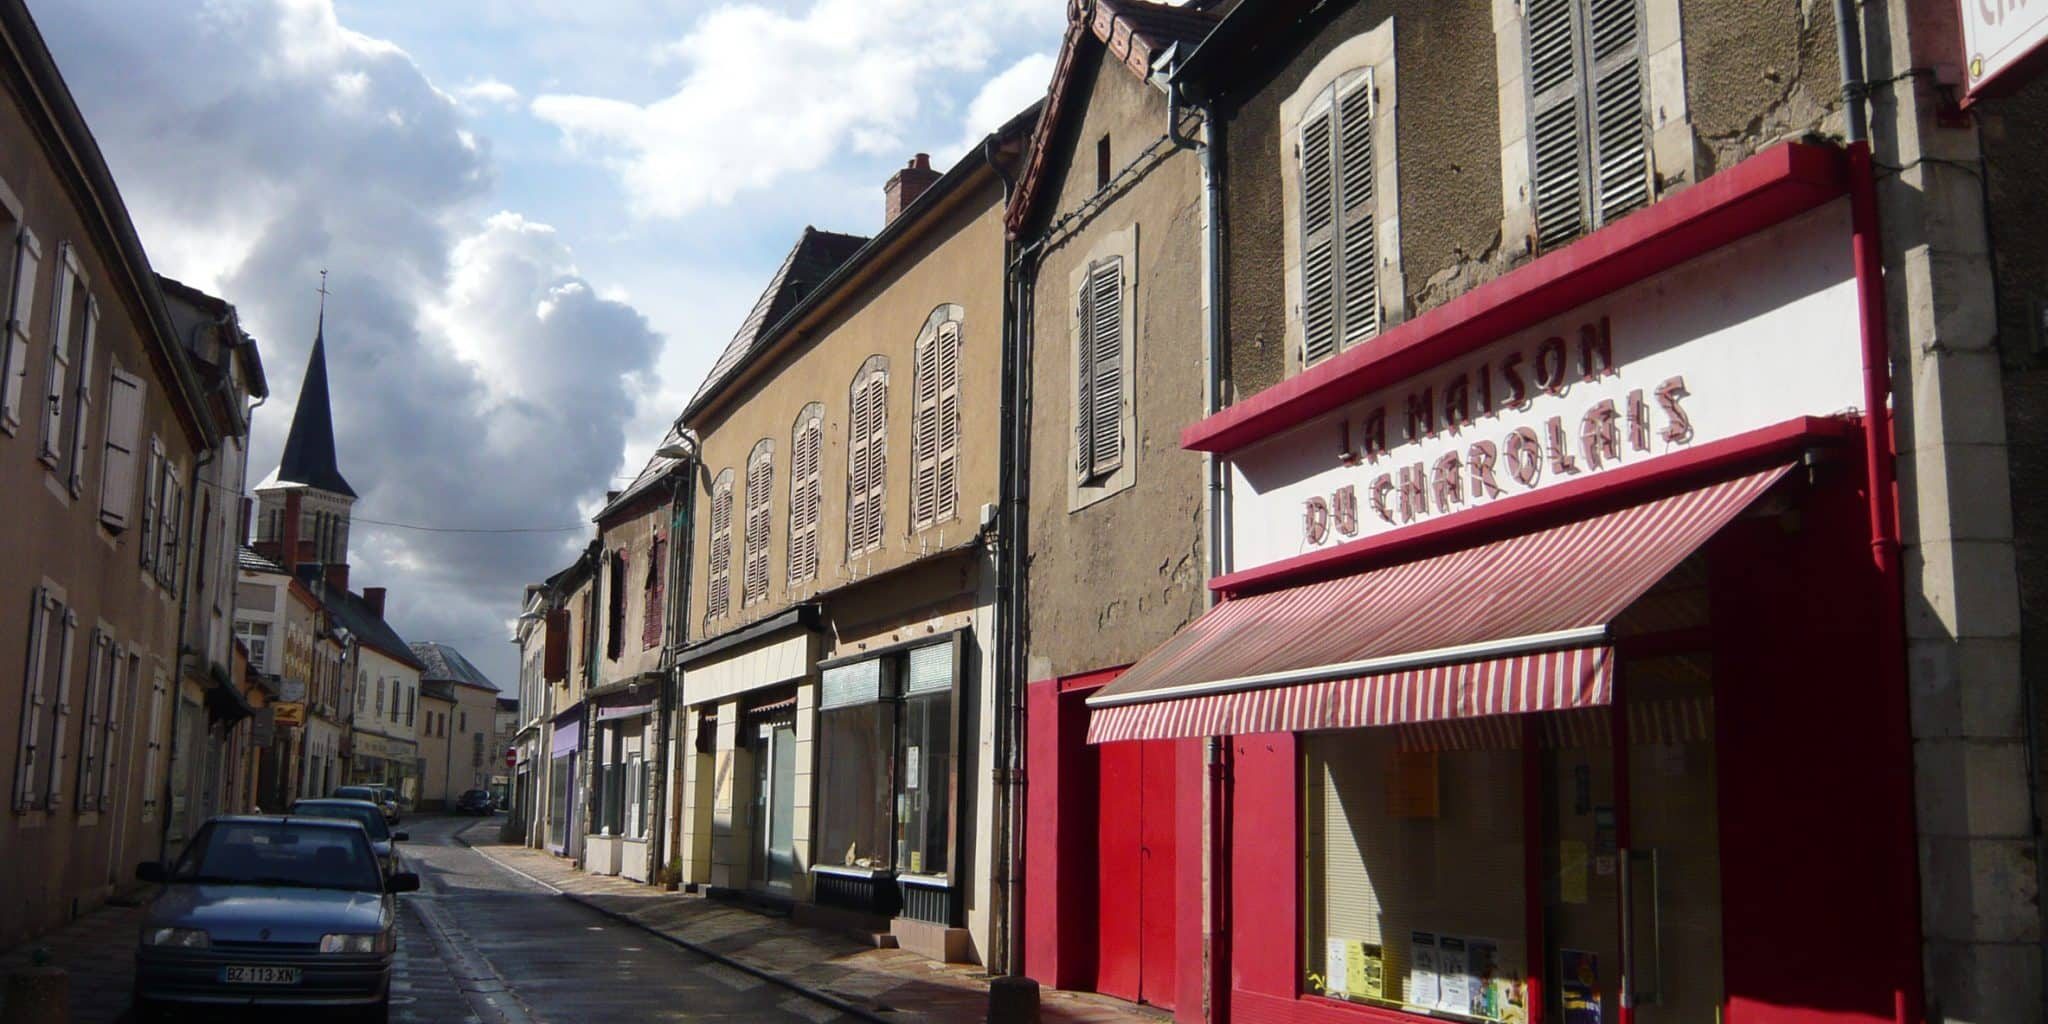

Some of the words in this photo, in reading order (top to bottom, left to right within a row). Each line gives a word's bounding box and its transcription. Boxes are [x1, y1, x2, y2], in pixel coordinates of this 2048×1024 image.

[1303, 485, 1358, 546] DU
[1369, 375, 1692, 525] CHAROLAIS
[1339, 406, 1390, 467] LA
[1404, 316, 1616, 444] MAISON
